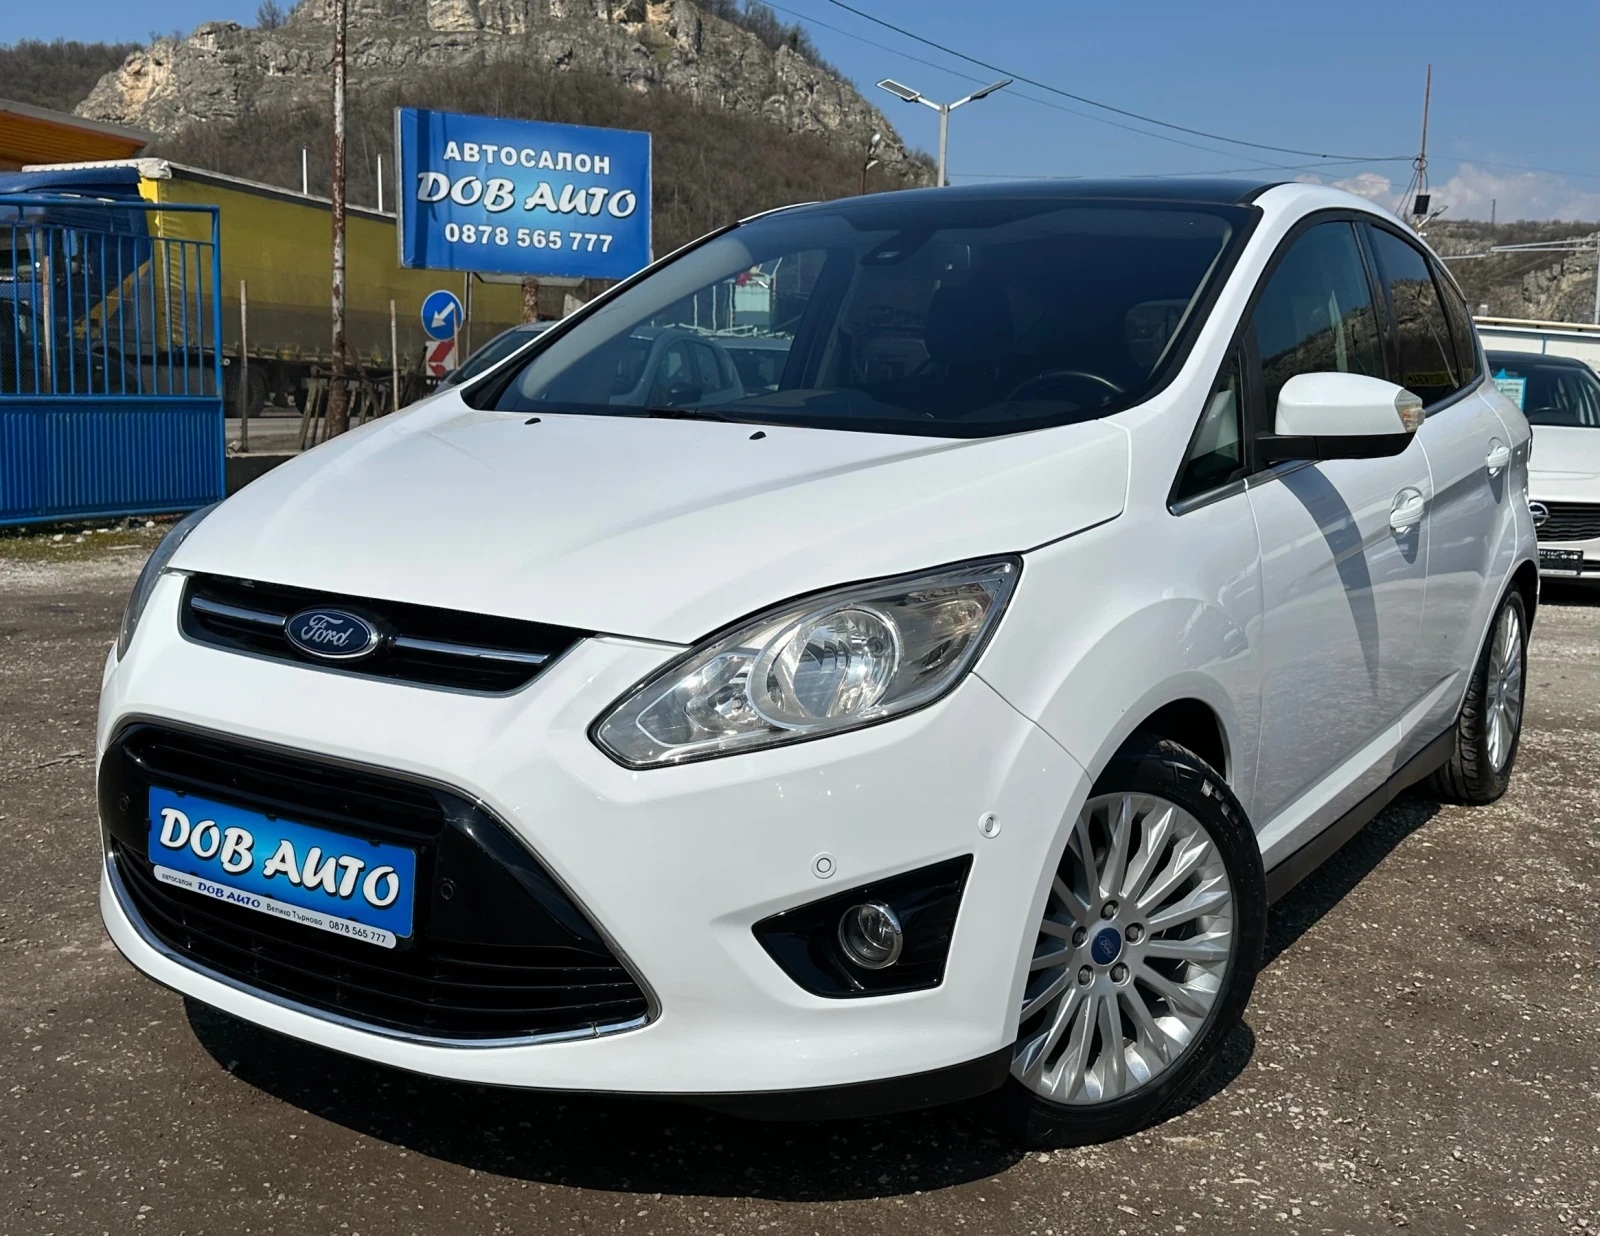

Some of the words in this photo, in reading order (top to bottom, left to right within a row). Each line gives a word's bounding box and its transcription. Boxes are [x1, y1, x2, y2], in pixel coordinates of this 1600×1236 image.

[443, 141, 610, 175] АВТОСАЛОН
[417, 171, 515, 212] DOB
[444, 223, 509, 246] 0878
[517, 228, 562, 249] 565
[569, 232, 613, 253] 777
[301, 614, 354, 647] Ford
[159, 807, 254, 873] DOB
[197, 881, 224, 898] DOB
[266, 903, 291, 917] Велико
[292, 910, 323, 926] Търново
[329, 920, 350, 934] 0878
[352, 926, 368, 939] 565
[370, 931, 387, 943] 777
